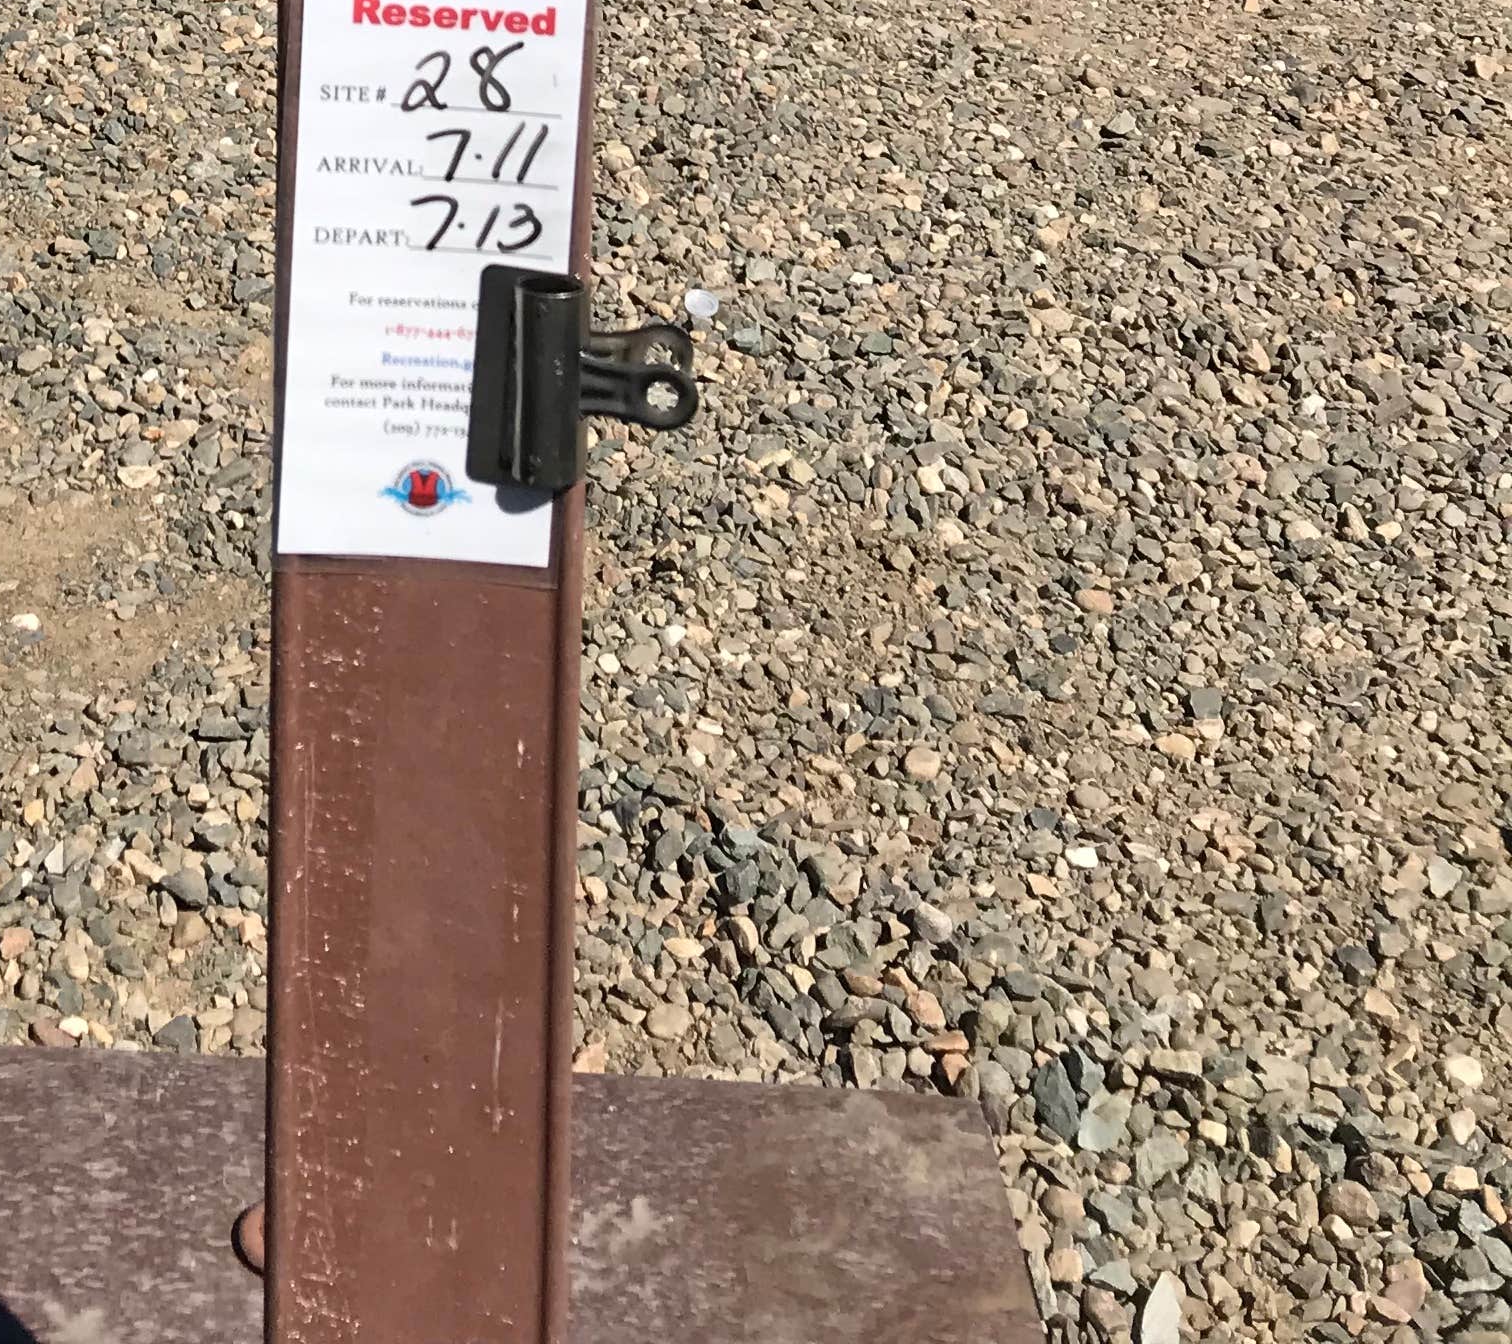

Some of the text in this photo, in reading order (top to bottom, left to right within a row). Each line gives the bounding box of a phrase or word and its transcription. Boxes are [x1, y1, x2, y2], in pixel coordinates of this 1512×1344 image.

[320, 85, 370, 102] SITE
[400, 41, 525, 112] 28
[349, 290, 373, 306] For
[377, 295, 466, 310] reservations
[382, 351, 474, 371] Recreation.g
[331, 374, 354, 389] For
[360, 379, 397, 390] more
[324, 395, 471, 416] contact Park Headq
